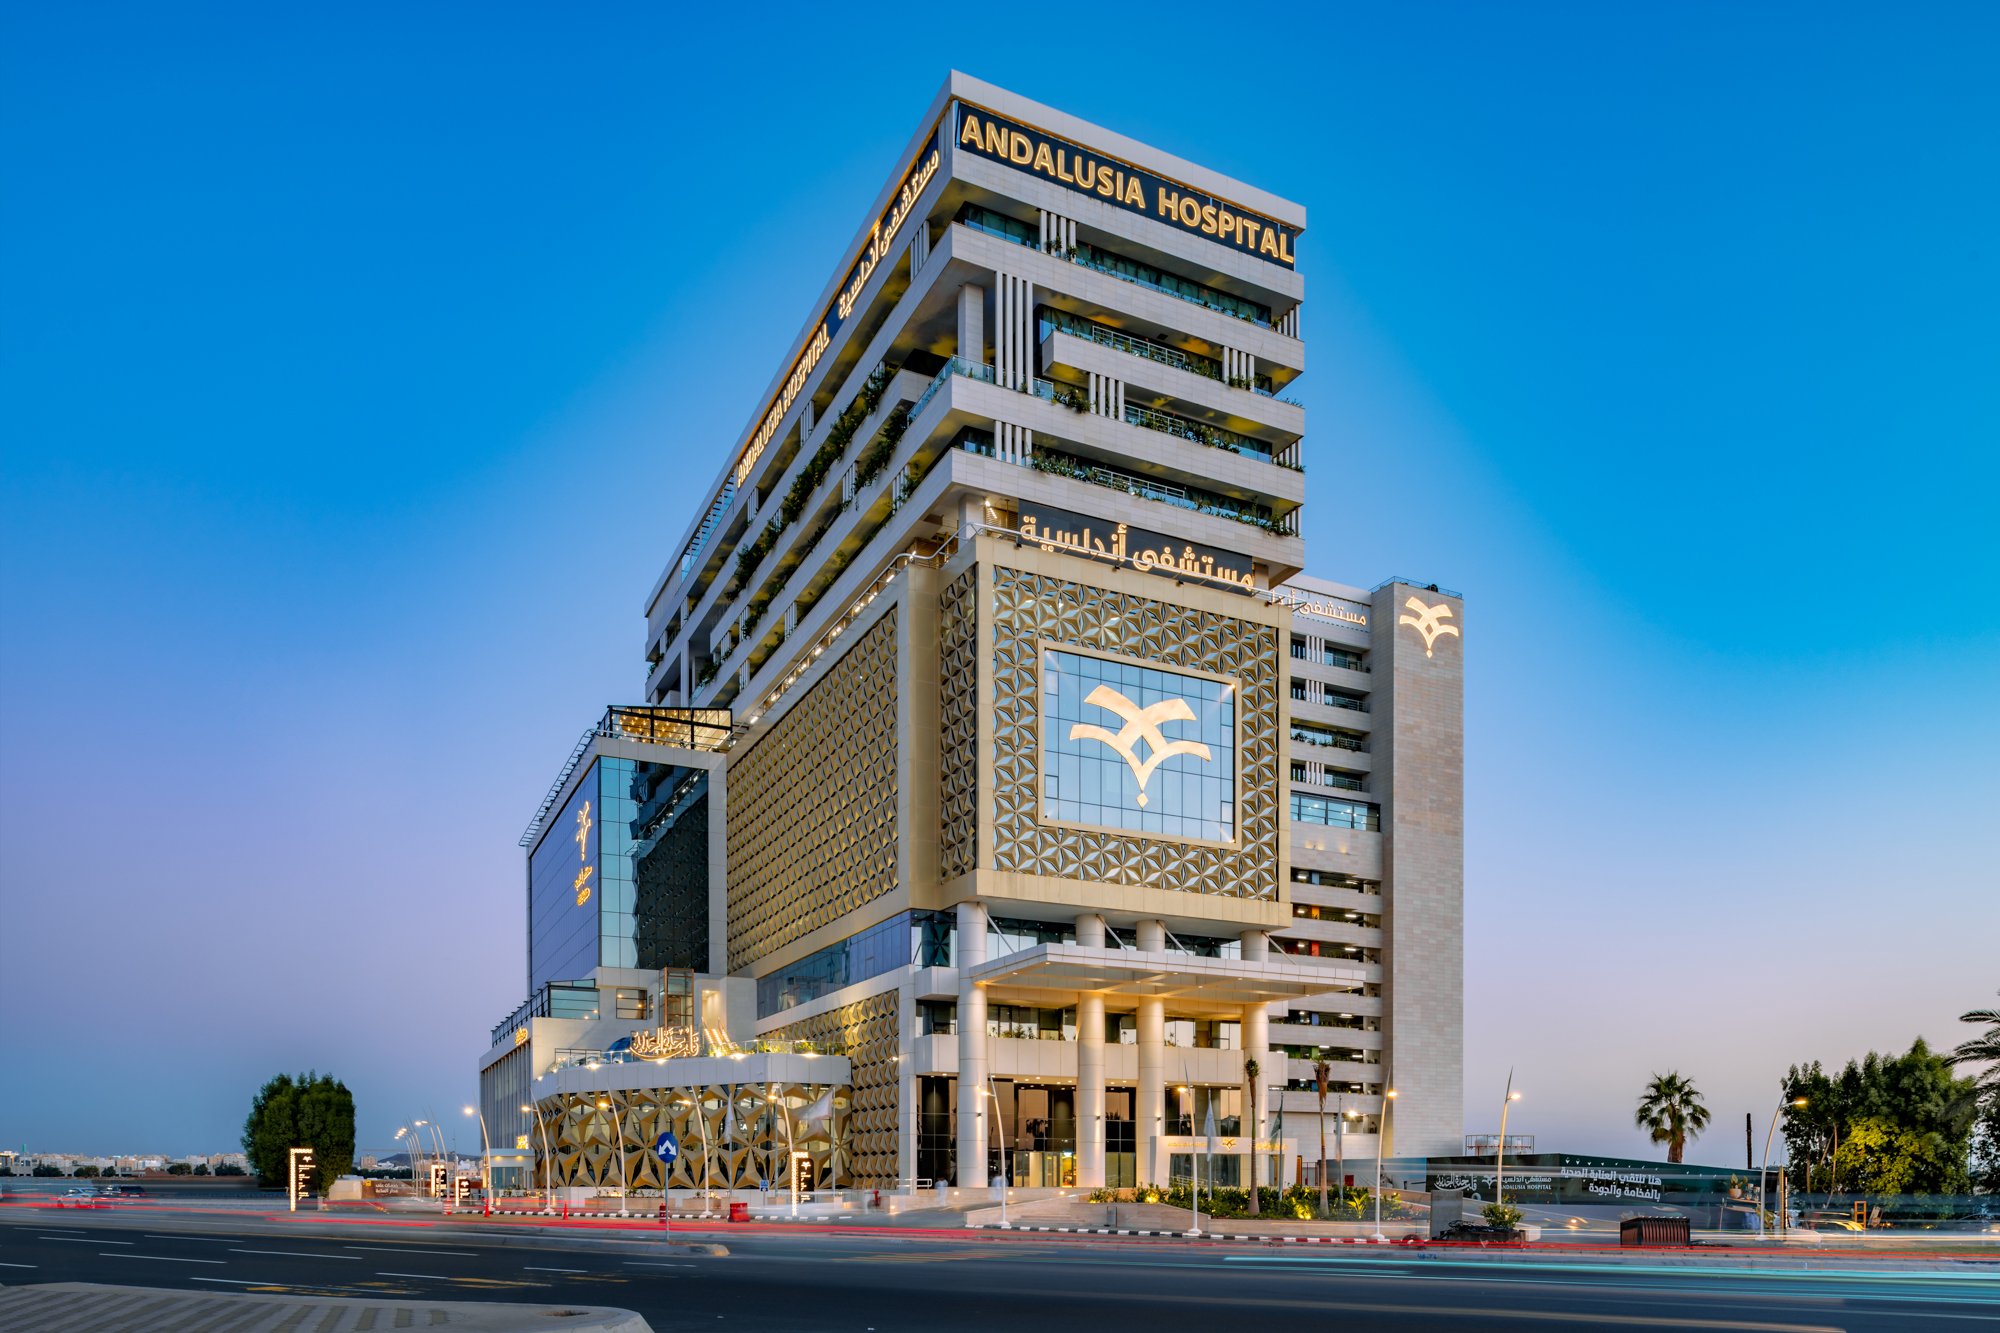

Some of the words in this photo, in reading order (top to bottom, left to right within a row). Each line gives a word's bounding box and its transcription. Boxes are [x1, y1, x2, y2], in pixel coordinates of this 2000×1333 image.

[961, 114, 1146, 209] ANDALUSIA
[1158, 187, 1295, 264] HOSPITAL
[881, 149, 939, 257] مستشفى
[838, 221, 881, 320] أندلسية
[737, 399, 783, 489] ANDALUSIA
[783, 322, 830, 413] HOSPITAL
[1019, 515, 1128, 562] أندلسية
[1132, 546, 1255, 592] مستشفى
[1299, 600, 1367, 626] مستشفى
[1560, 1166, 1588, 1178] الصحية
[1589, 1169, 1617, 1181] العناية
[1618, 1173, 1647, 1184] تلتقي
[1647, 1174, 1662, 1186] هنا
[1588, 1183, 1622, 1198] والجودة
[1623, 1186, 1661, 1202] بالفخامة
